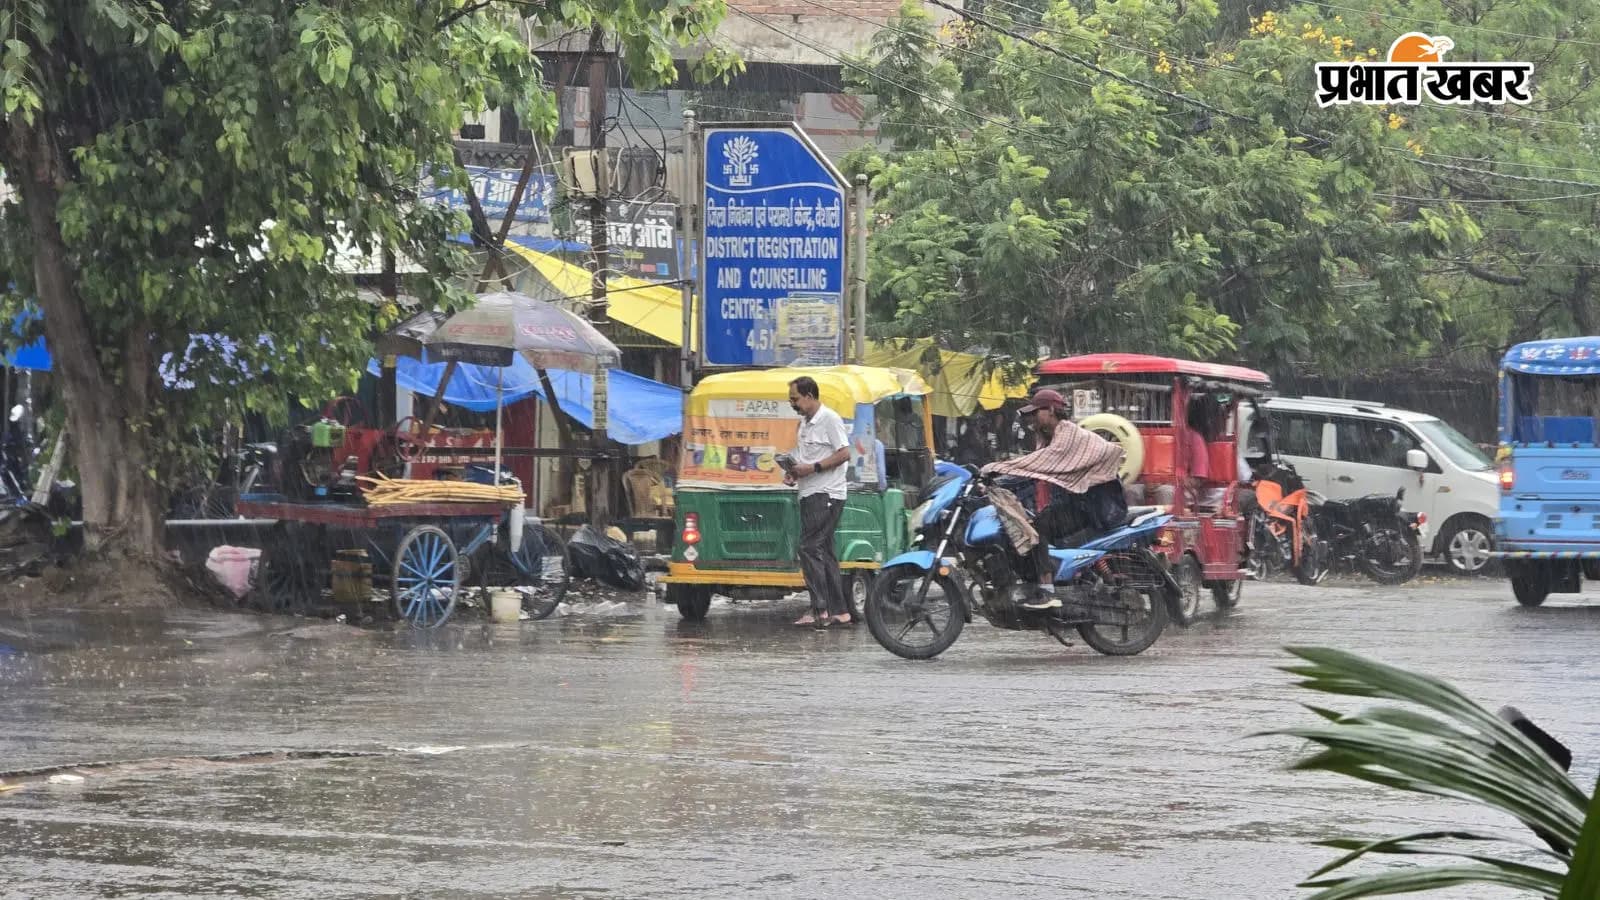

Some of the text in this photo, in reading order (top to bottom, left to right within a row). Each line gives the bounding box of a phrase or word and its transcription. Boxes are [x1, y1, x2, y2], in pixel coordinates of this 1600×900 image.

[707, 197, 726, 228] जिला
[815, 197, 840, 228] वैशाली
[635, 218, 673, 248] ऑटो
[706, 237, 838, 259] DISTRICT REGISTRATION
[717, 268, 827, 290] AND COUNSELLING
[746, 401, 779, 413] APAR
